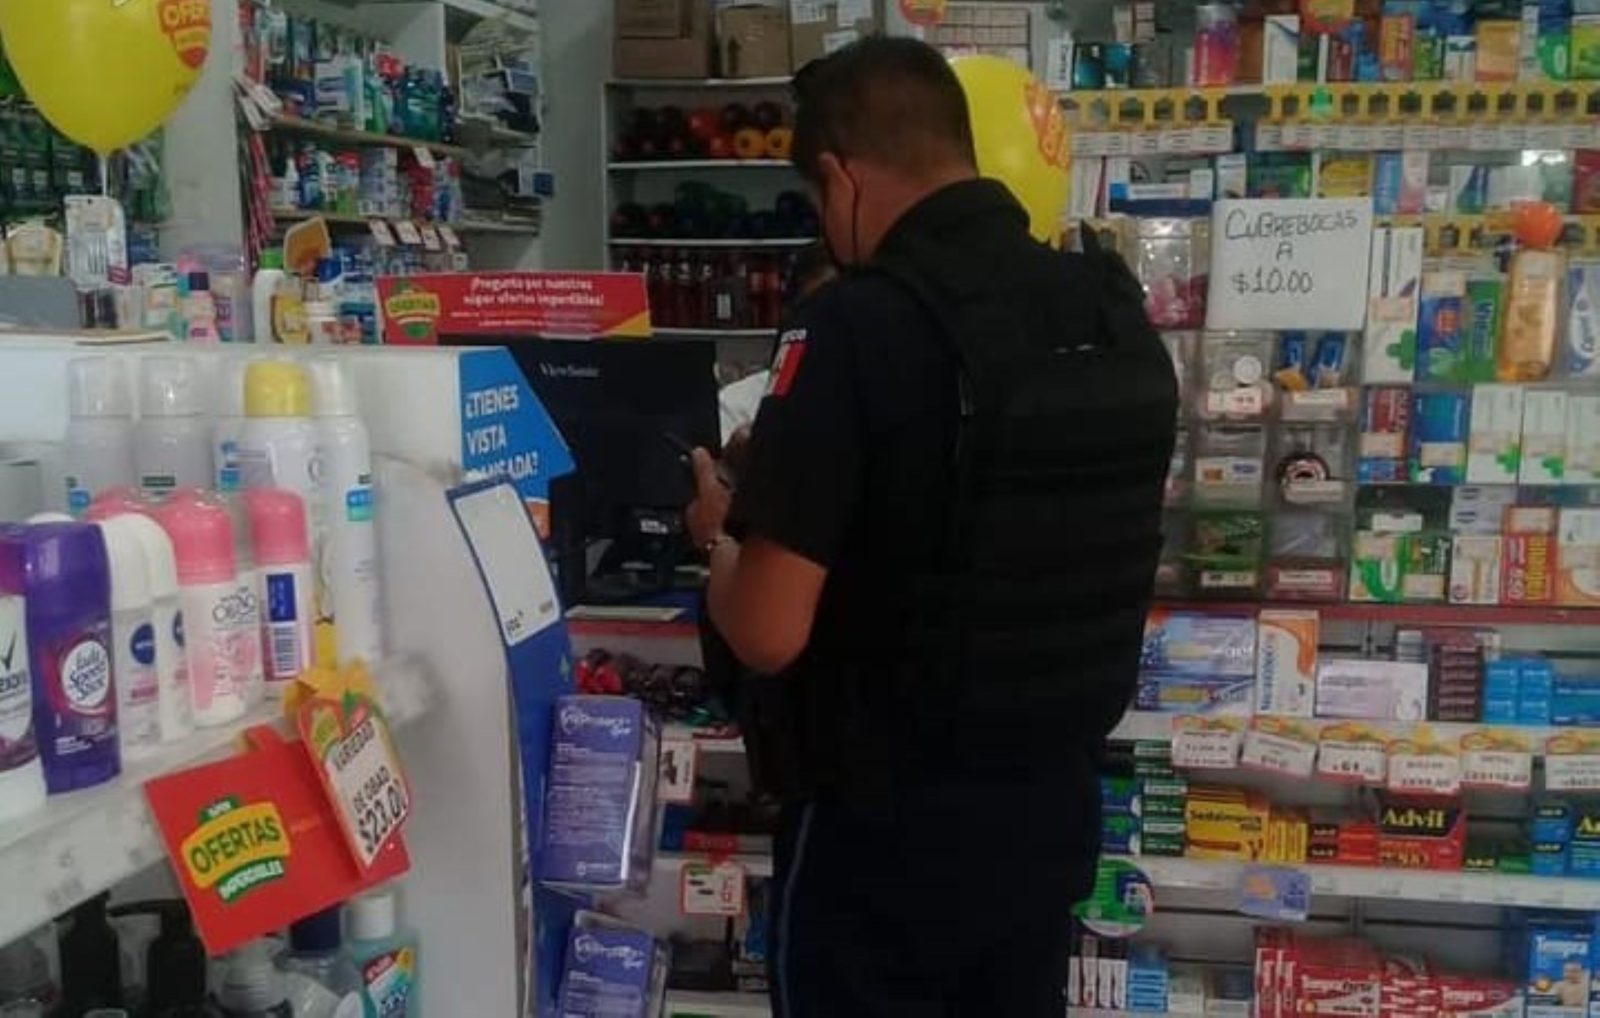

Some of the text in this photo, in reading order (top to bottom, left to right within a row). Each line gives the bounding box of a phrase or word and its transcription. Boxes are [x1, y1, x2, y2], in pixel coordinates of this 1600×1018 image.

[1275, 240, 1294, 261] A
[1231, 265, 1314, 294] $10.00
[467, 424, 507, 455] VISTA
[1382, 808, 1445, 829] Advil
[190, 815, 281, 875] OFERTAS
